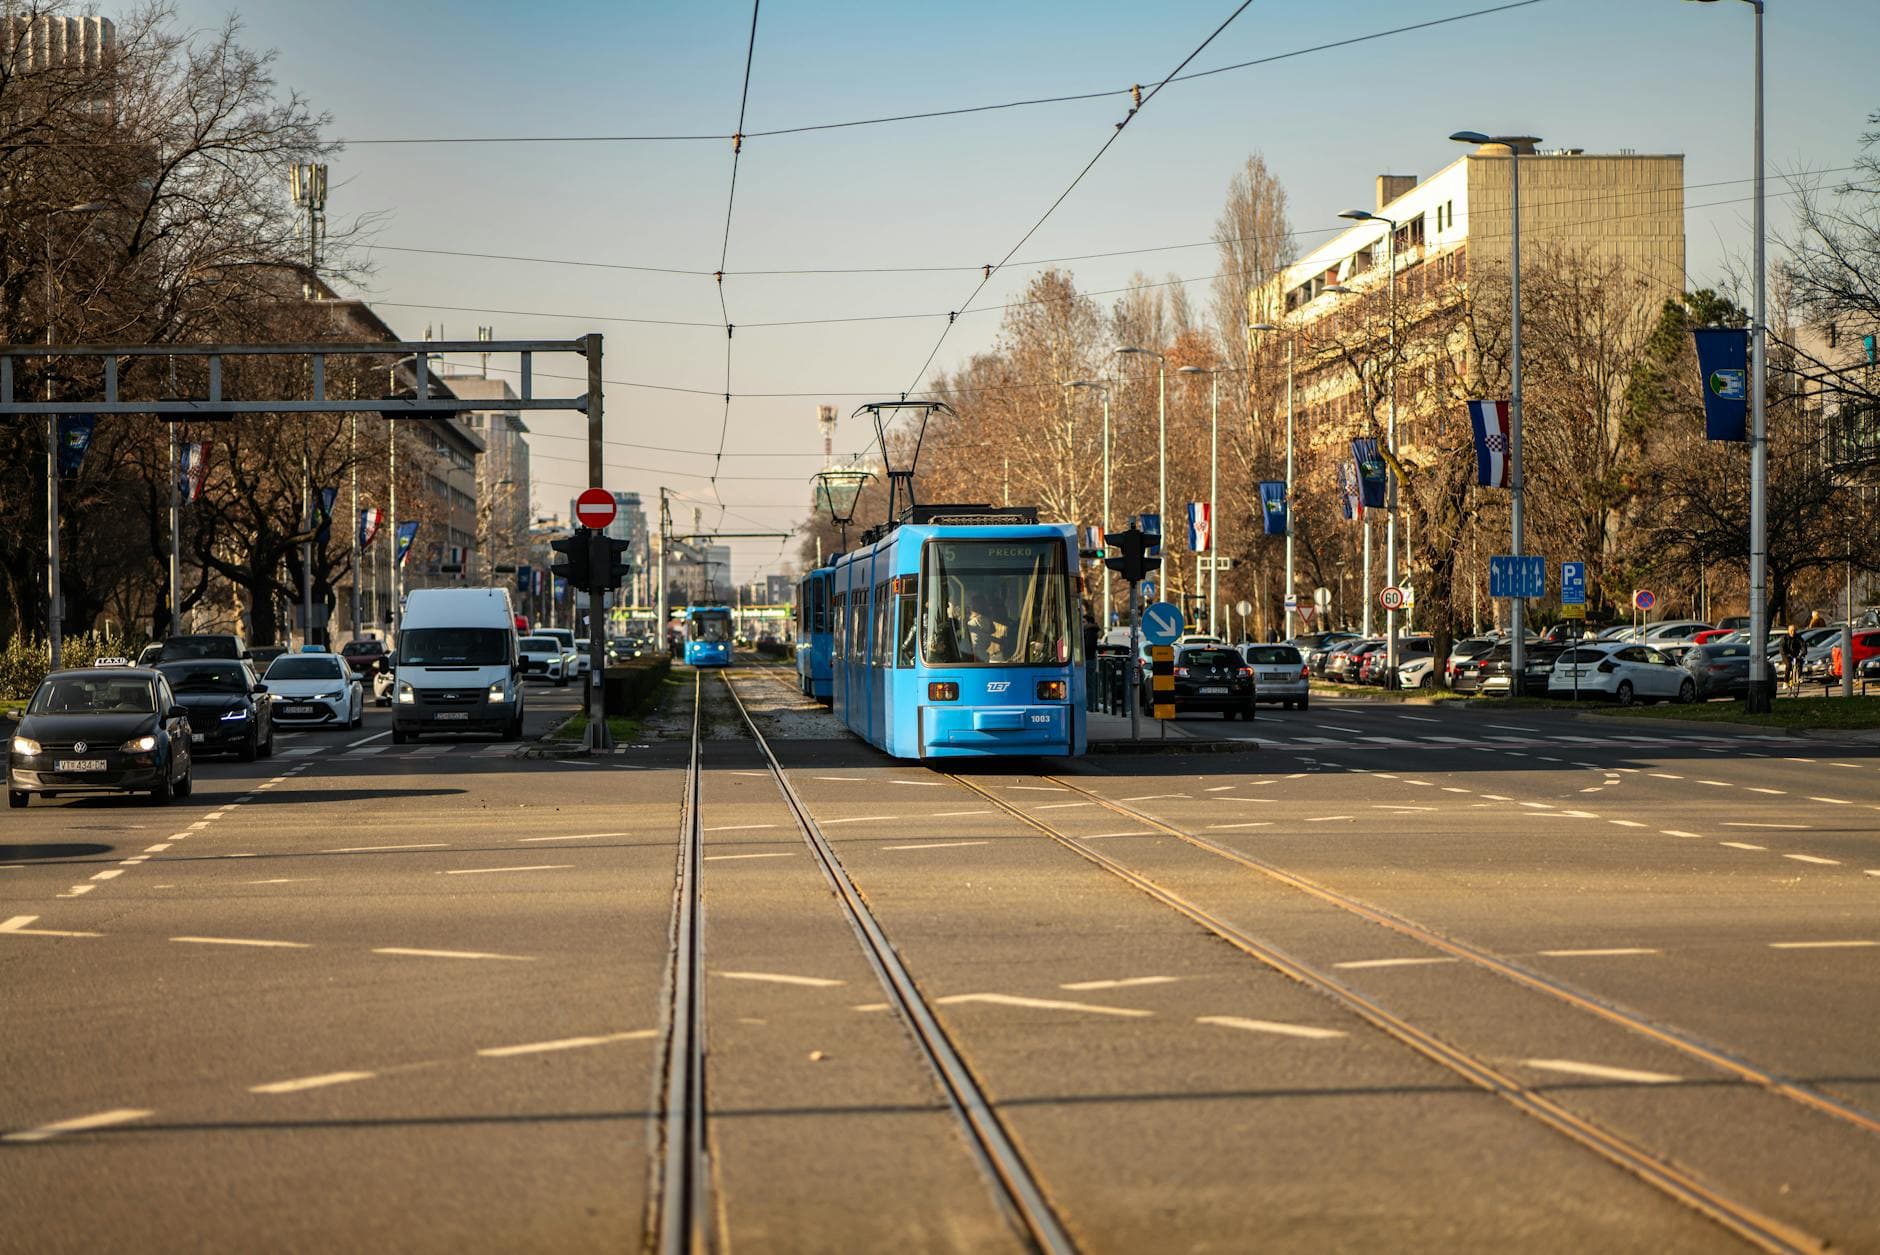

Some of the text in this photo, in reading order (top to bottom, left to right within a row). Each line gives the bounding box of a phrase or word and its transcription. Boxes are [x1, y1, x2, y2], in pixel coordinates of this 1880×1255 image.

[944, 545, 956, 561] 5
[1564, 564, 1576, 586] P
[1385, 592, 1399, 605] 60
[98, 657, 124, 665] TAXI
[987, 681, 1011, 693] ZET
[1031, 715, 1051, 723] 1003
